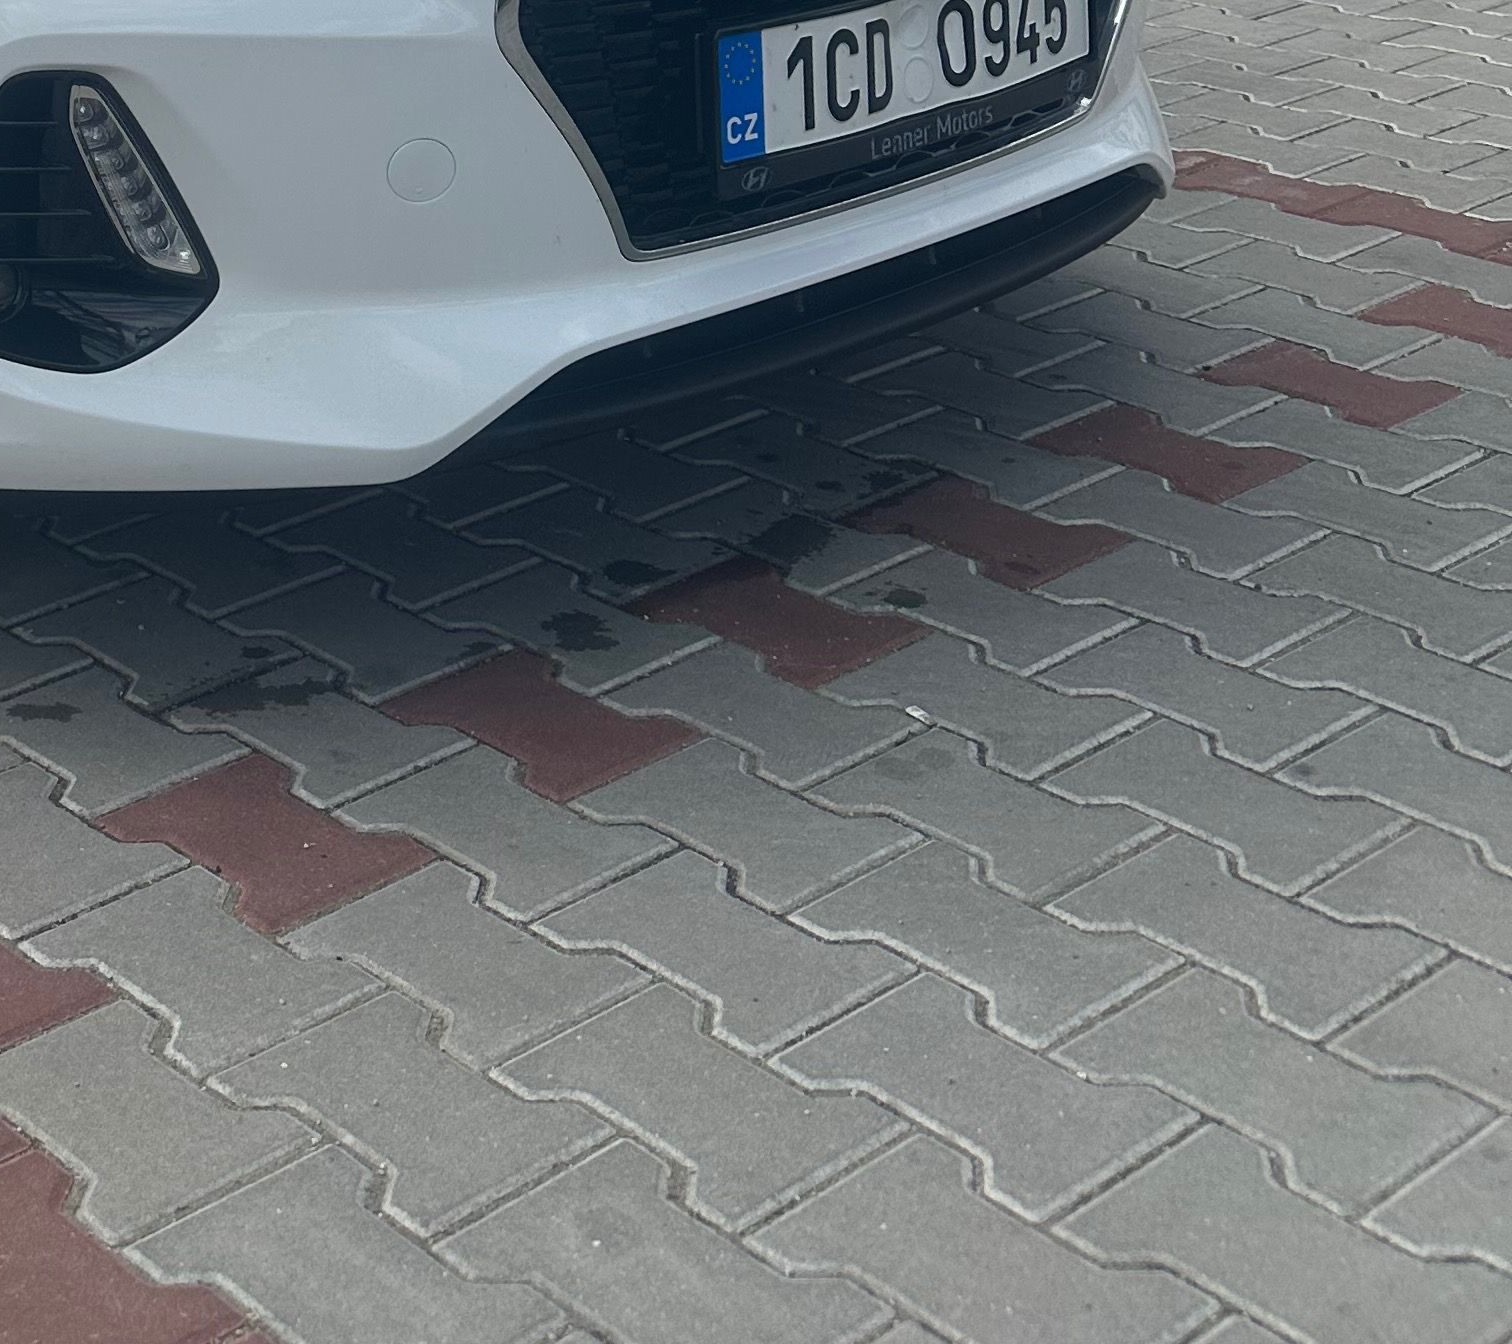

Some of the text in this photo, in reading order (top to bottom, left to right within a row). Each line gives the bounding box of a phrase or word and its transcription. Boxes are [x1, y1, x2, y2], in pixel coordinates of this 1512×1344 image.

[786, 18, 895, 132] 1CD
[726, 112, 759, 145] CZ
[870, 103, 994, 160] Lenner Motors
